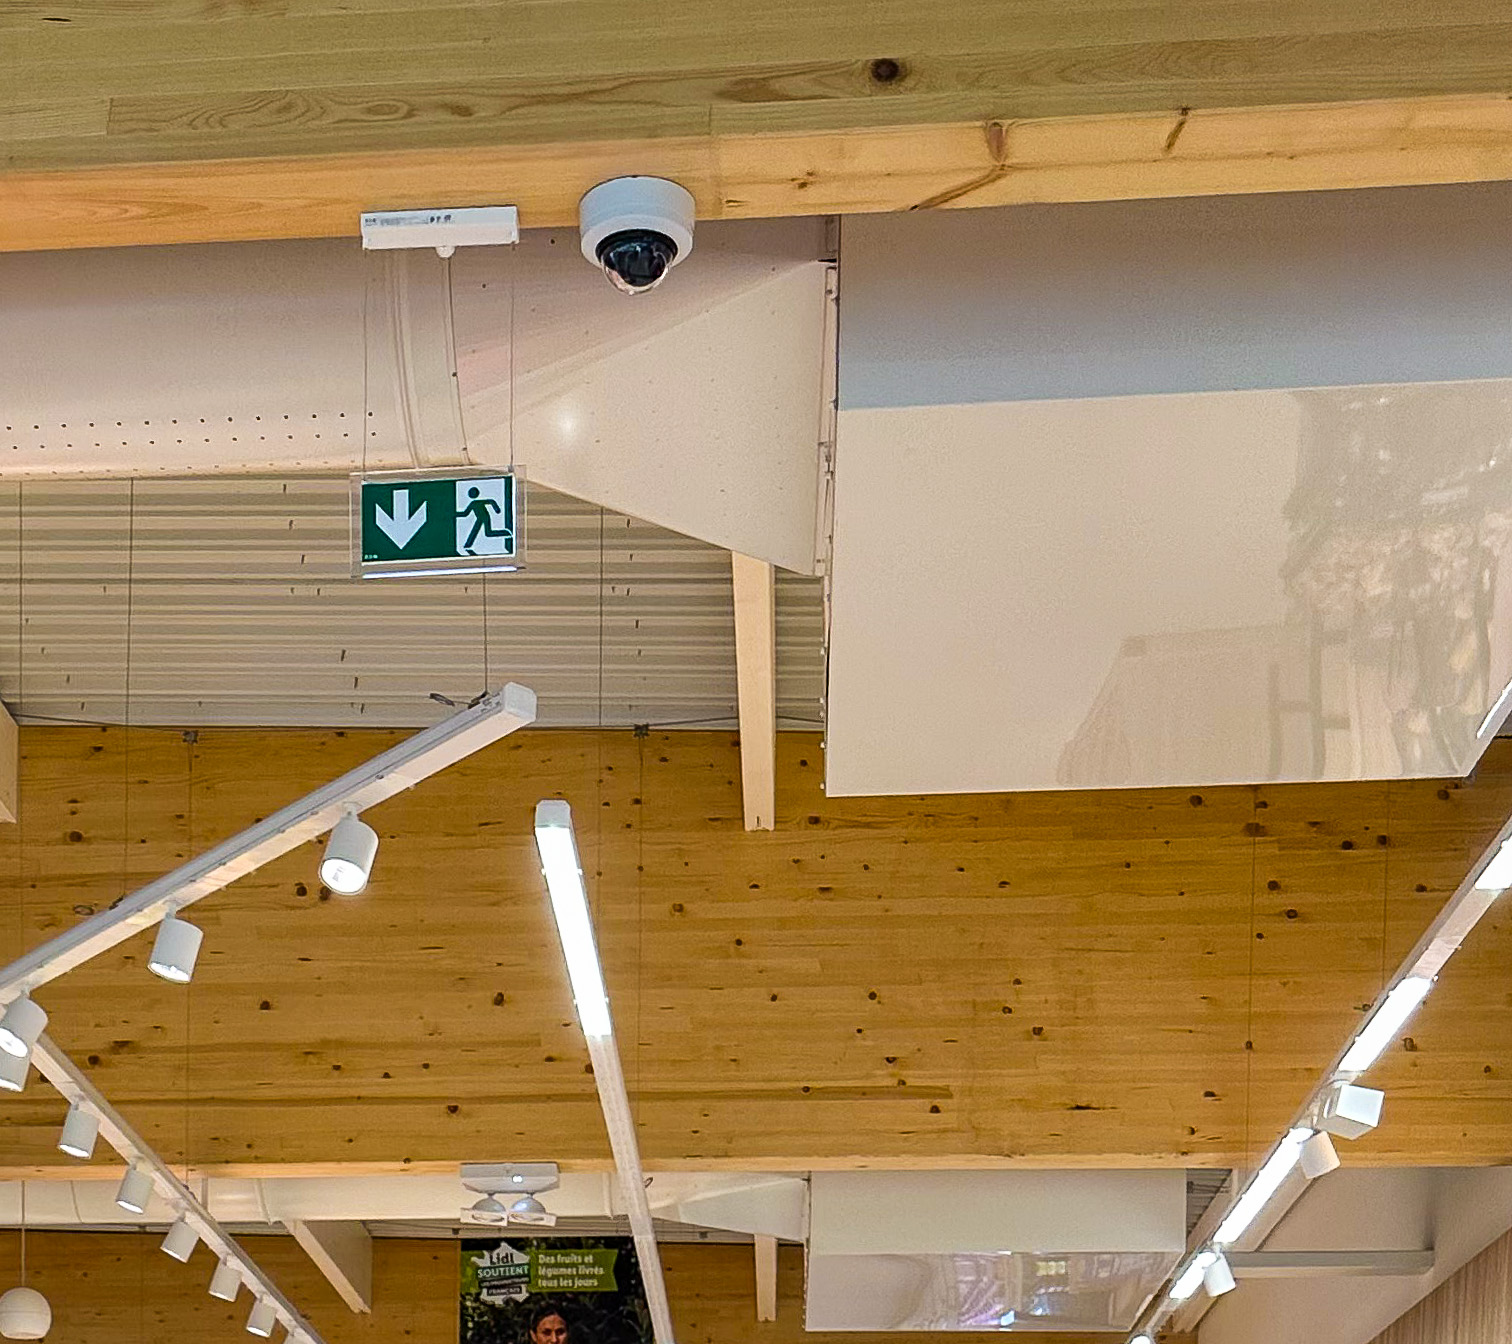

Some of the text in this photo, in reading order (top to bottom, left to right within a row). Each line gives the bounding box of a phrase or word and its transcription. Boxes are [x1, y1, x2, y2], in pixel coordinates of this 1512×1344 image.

[490, 1253, 514, 1265] Lidl
[538, 1254, 594, 1263] Des fruits et
[477, 1265, 529, 1278] SOUTIENT
[538, 1265, 604, 1277] légumes livrés
[538, 1278, 558, 1287] tous
[559, 1278, 573, 1287] les
[574, 1278, 598, 1288] jours
